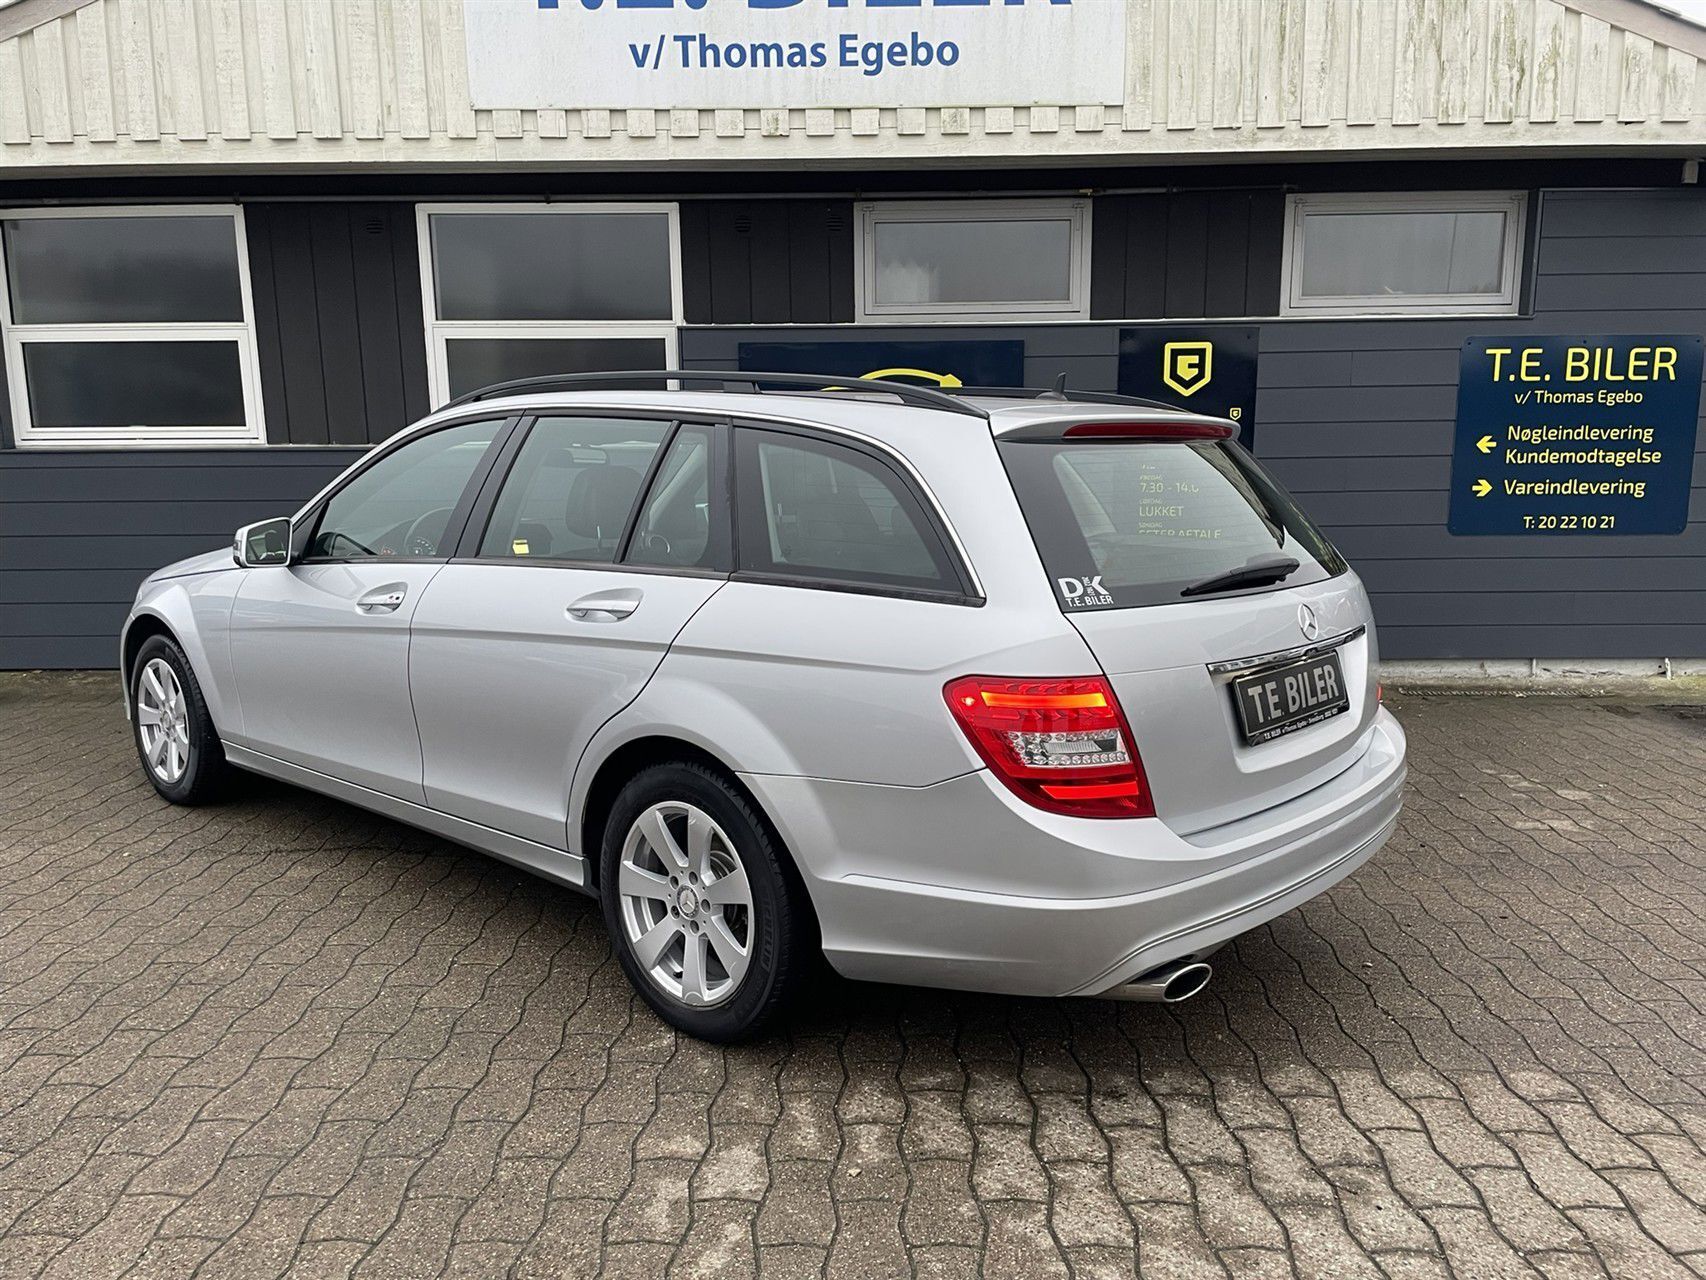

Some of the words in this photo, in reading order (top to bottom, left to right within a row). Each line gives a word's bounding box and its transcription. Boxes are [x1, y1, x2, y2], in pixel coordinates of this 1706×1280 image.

[629, 34, 665, 70] v/
[673, 33, 827, 69] Thomas
[839, 31, 960, 77] Egebo
[1485, 347, 1551, 382] T.E.
[1565, 346, 1678, 382] BILER
[1514, 390, 1532, 405] v/
[1534, 390, 1594, 404] Thomas
[1597, 389, 1643, 406] Egebo
[1507, 425, 1655, 444] Nøgleindlevering
[1505, 448, 1662, 467] Kundemodtagelse
[1139, 482, 1164, 493] 7.30
[1504, 478, 1646, 498] Vareindlevering
[1139, 506, 1185, 517] LUKKET
[1523, 516, 1536, 529] T:
[1538, 516, 1557, 529] 20
[1560, 516, 1578, 529] 22
[1581, 516, 1597, 529] 10
[1600, 516, 1615, 529] 21
[1065, 597, 1085, 607] T.E.
[1084, 595, 1114, 606] BILER
[1284, 664, 1339, 713] BILER
